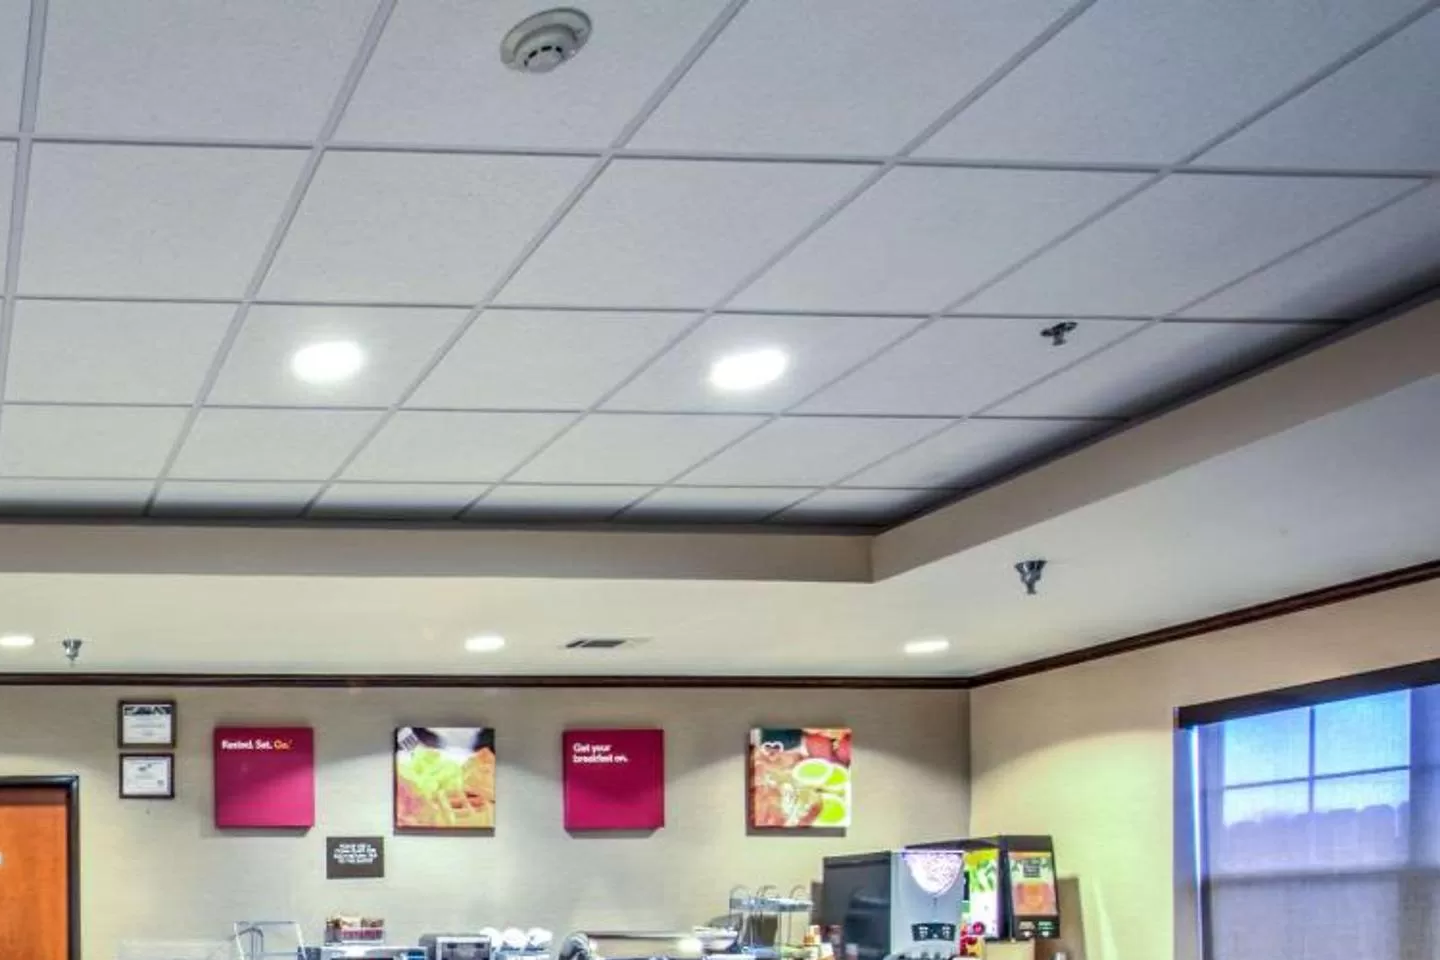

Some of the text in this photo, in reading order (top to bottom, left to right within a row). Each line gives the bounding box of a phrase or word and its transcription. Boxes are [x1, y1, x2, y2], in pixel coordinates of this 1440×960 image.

[255, 739, 273, 750] Set.
[573, 742, 612, 758] Get your
[572, 754, 613, 763] breakfast
